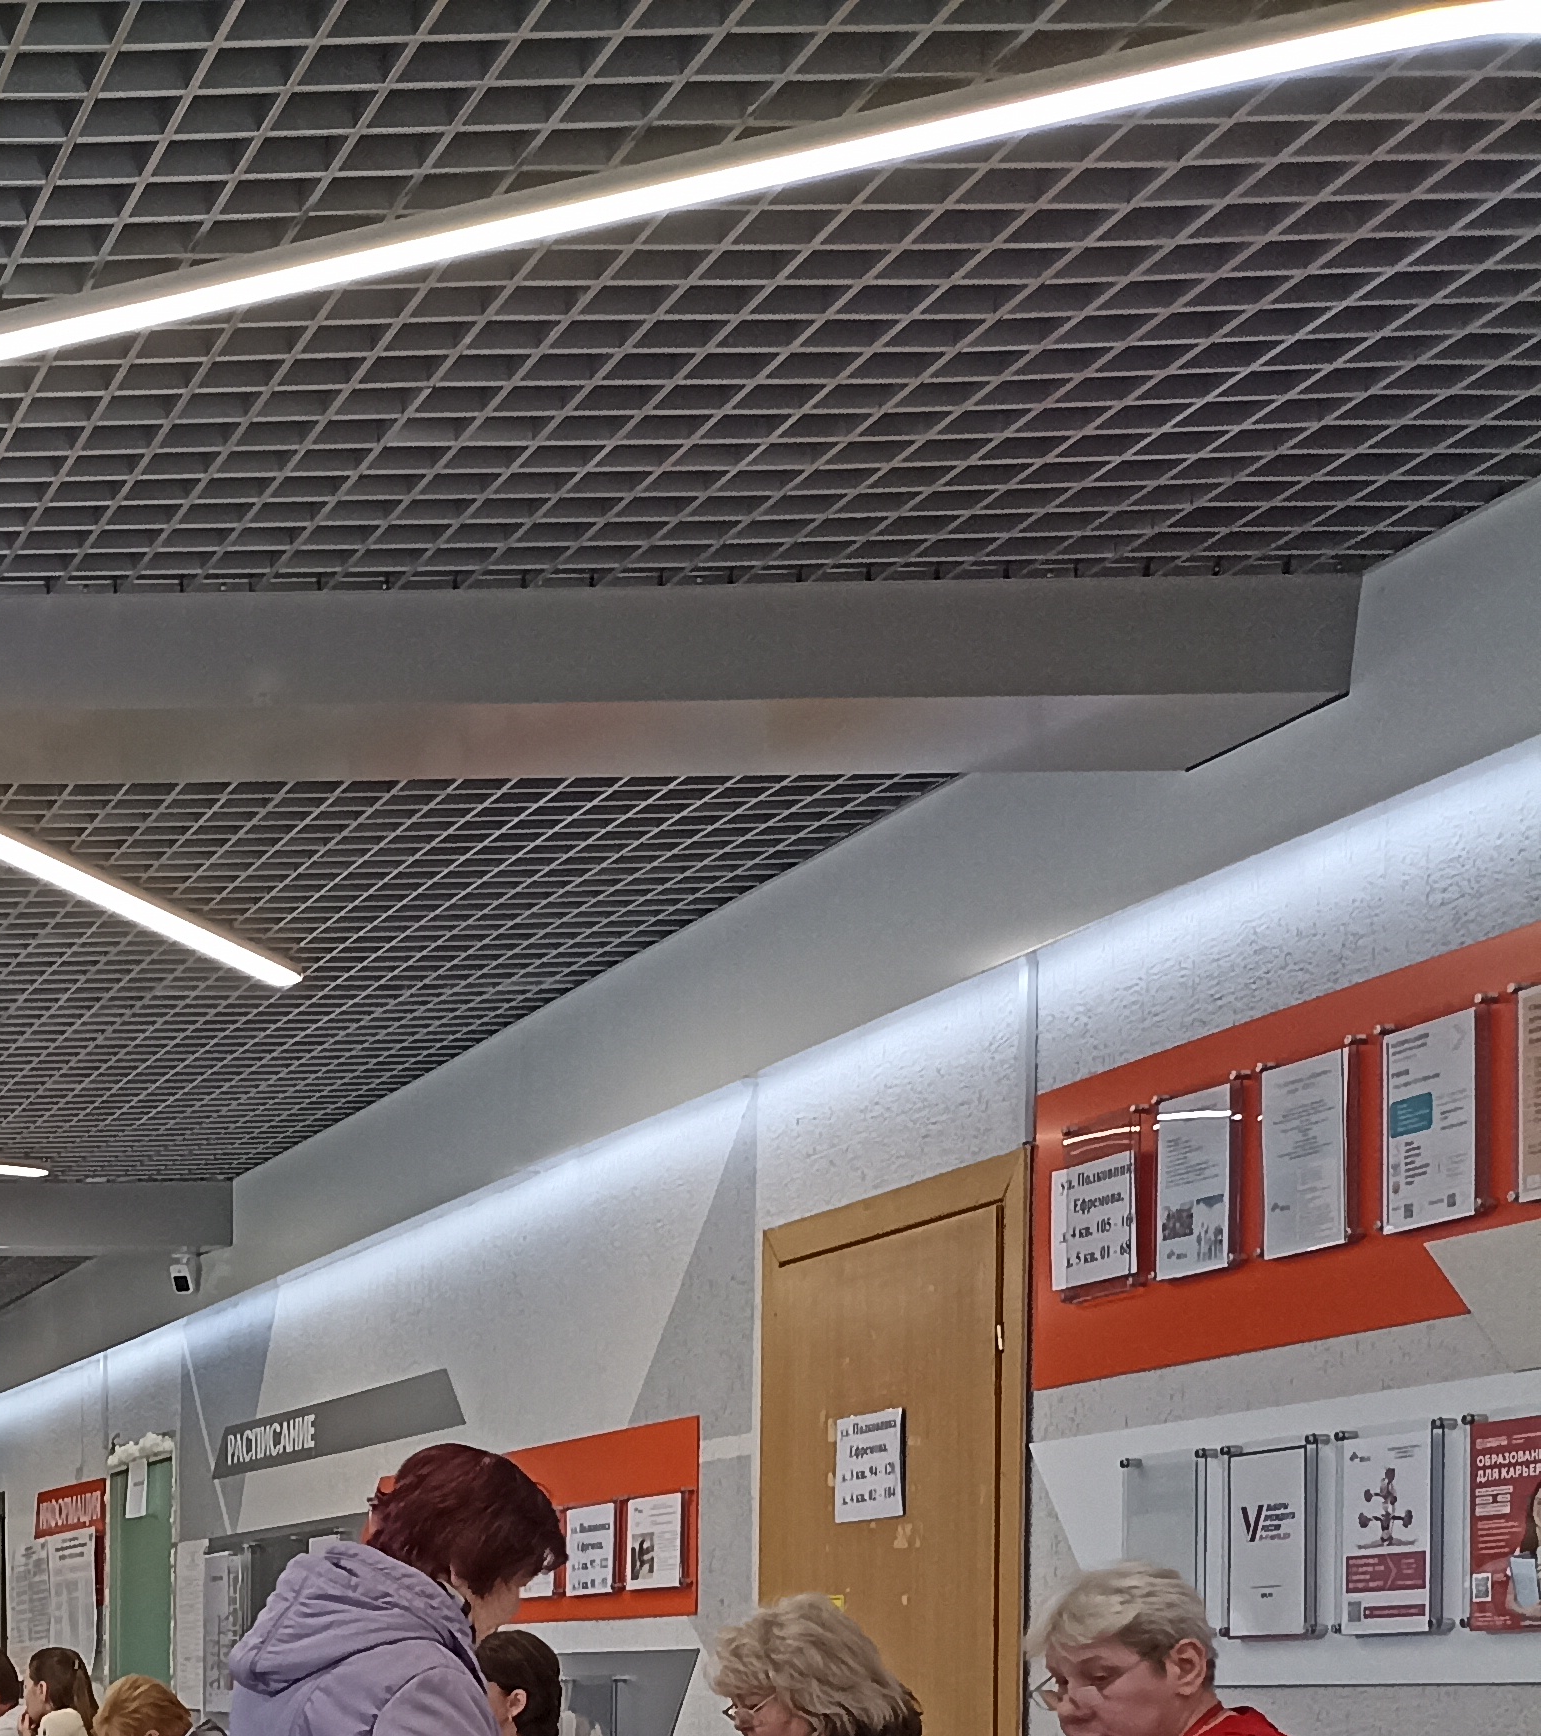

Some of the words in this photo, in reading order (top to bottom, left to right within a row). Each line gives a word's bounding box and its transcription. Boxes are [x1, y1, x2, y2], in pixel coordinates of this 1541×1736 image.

[227, 1413, 316, 1466] РАСПИСАНИЕ
[1476, 1468, 1499, 1484] ДЛЯ
[39, 1491, 101, 1530] ИНФОРМАЦИЯ
